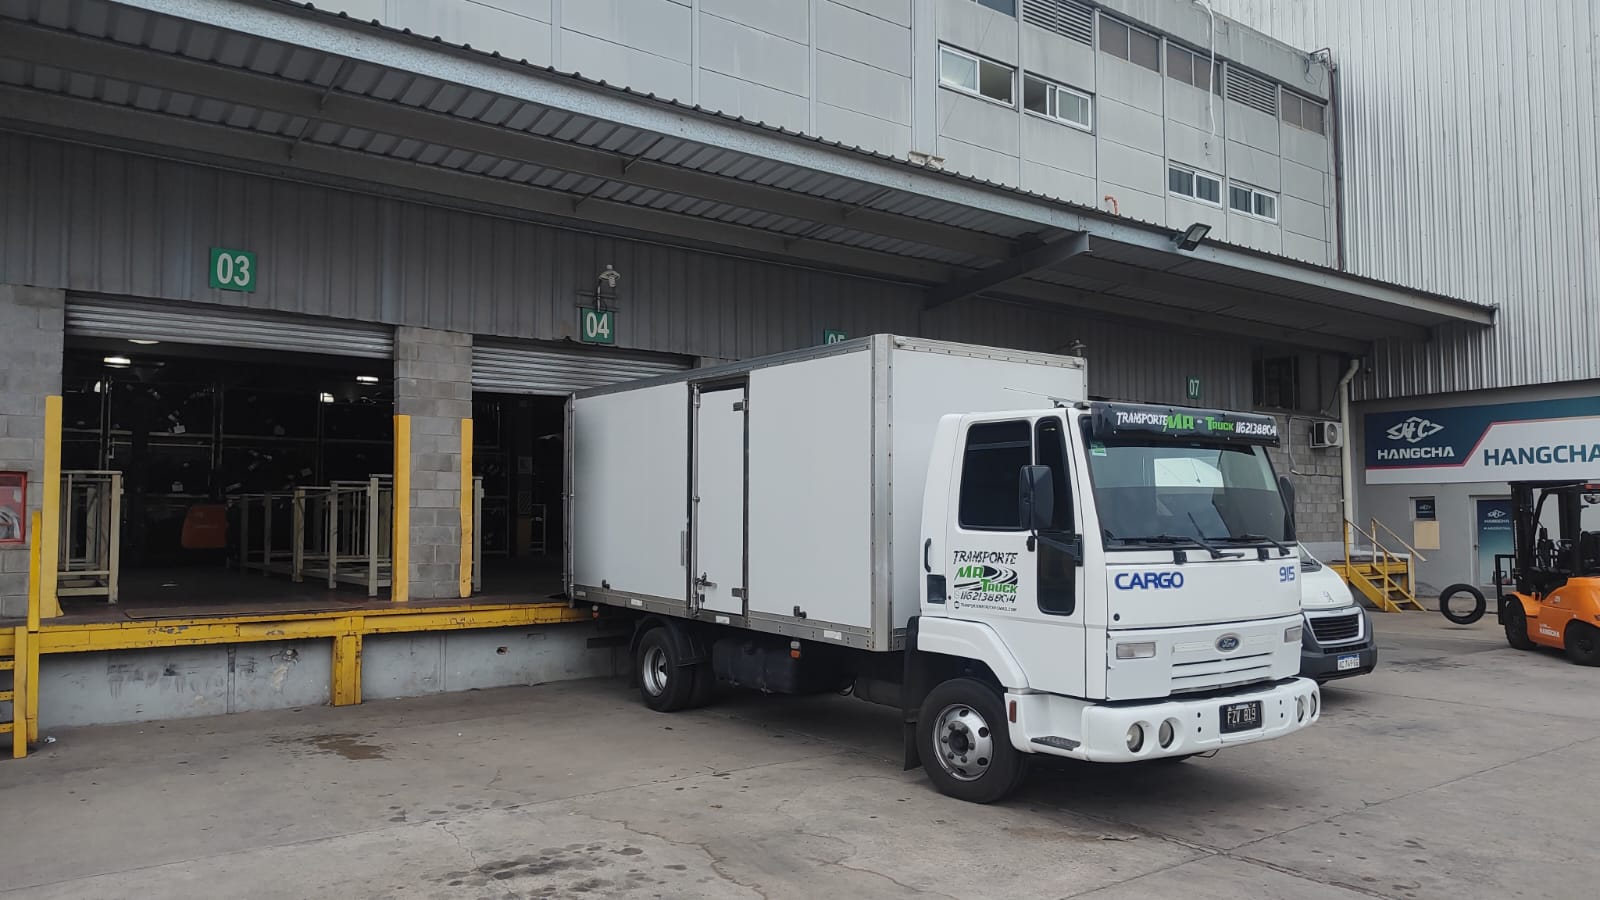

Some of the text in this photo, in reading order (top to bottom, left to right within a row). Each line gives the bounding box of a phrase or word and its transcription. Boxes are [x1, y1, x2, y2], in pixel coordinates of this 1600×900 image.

[217, 253, 250, 286] 03
[586, 312, 610, 339] 04
[1190, 379, 1200, 396] 07
[1116, 412, 1168, 426] TRANSPORTE
[1377, 447, 1455, 460] HANGCHA
[1484, 444, 1600, 466] HANGCHA
[953, 551, 1018, 565] TRANSPORTE
[1115, 572, 1184, 590] CARGO
[1279, 566, 1295, 583] 915
[1244, 708, 1256, 721] 819
